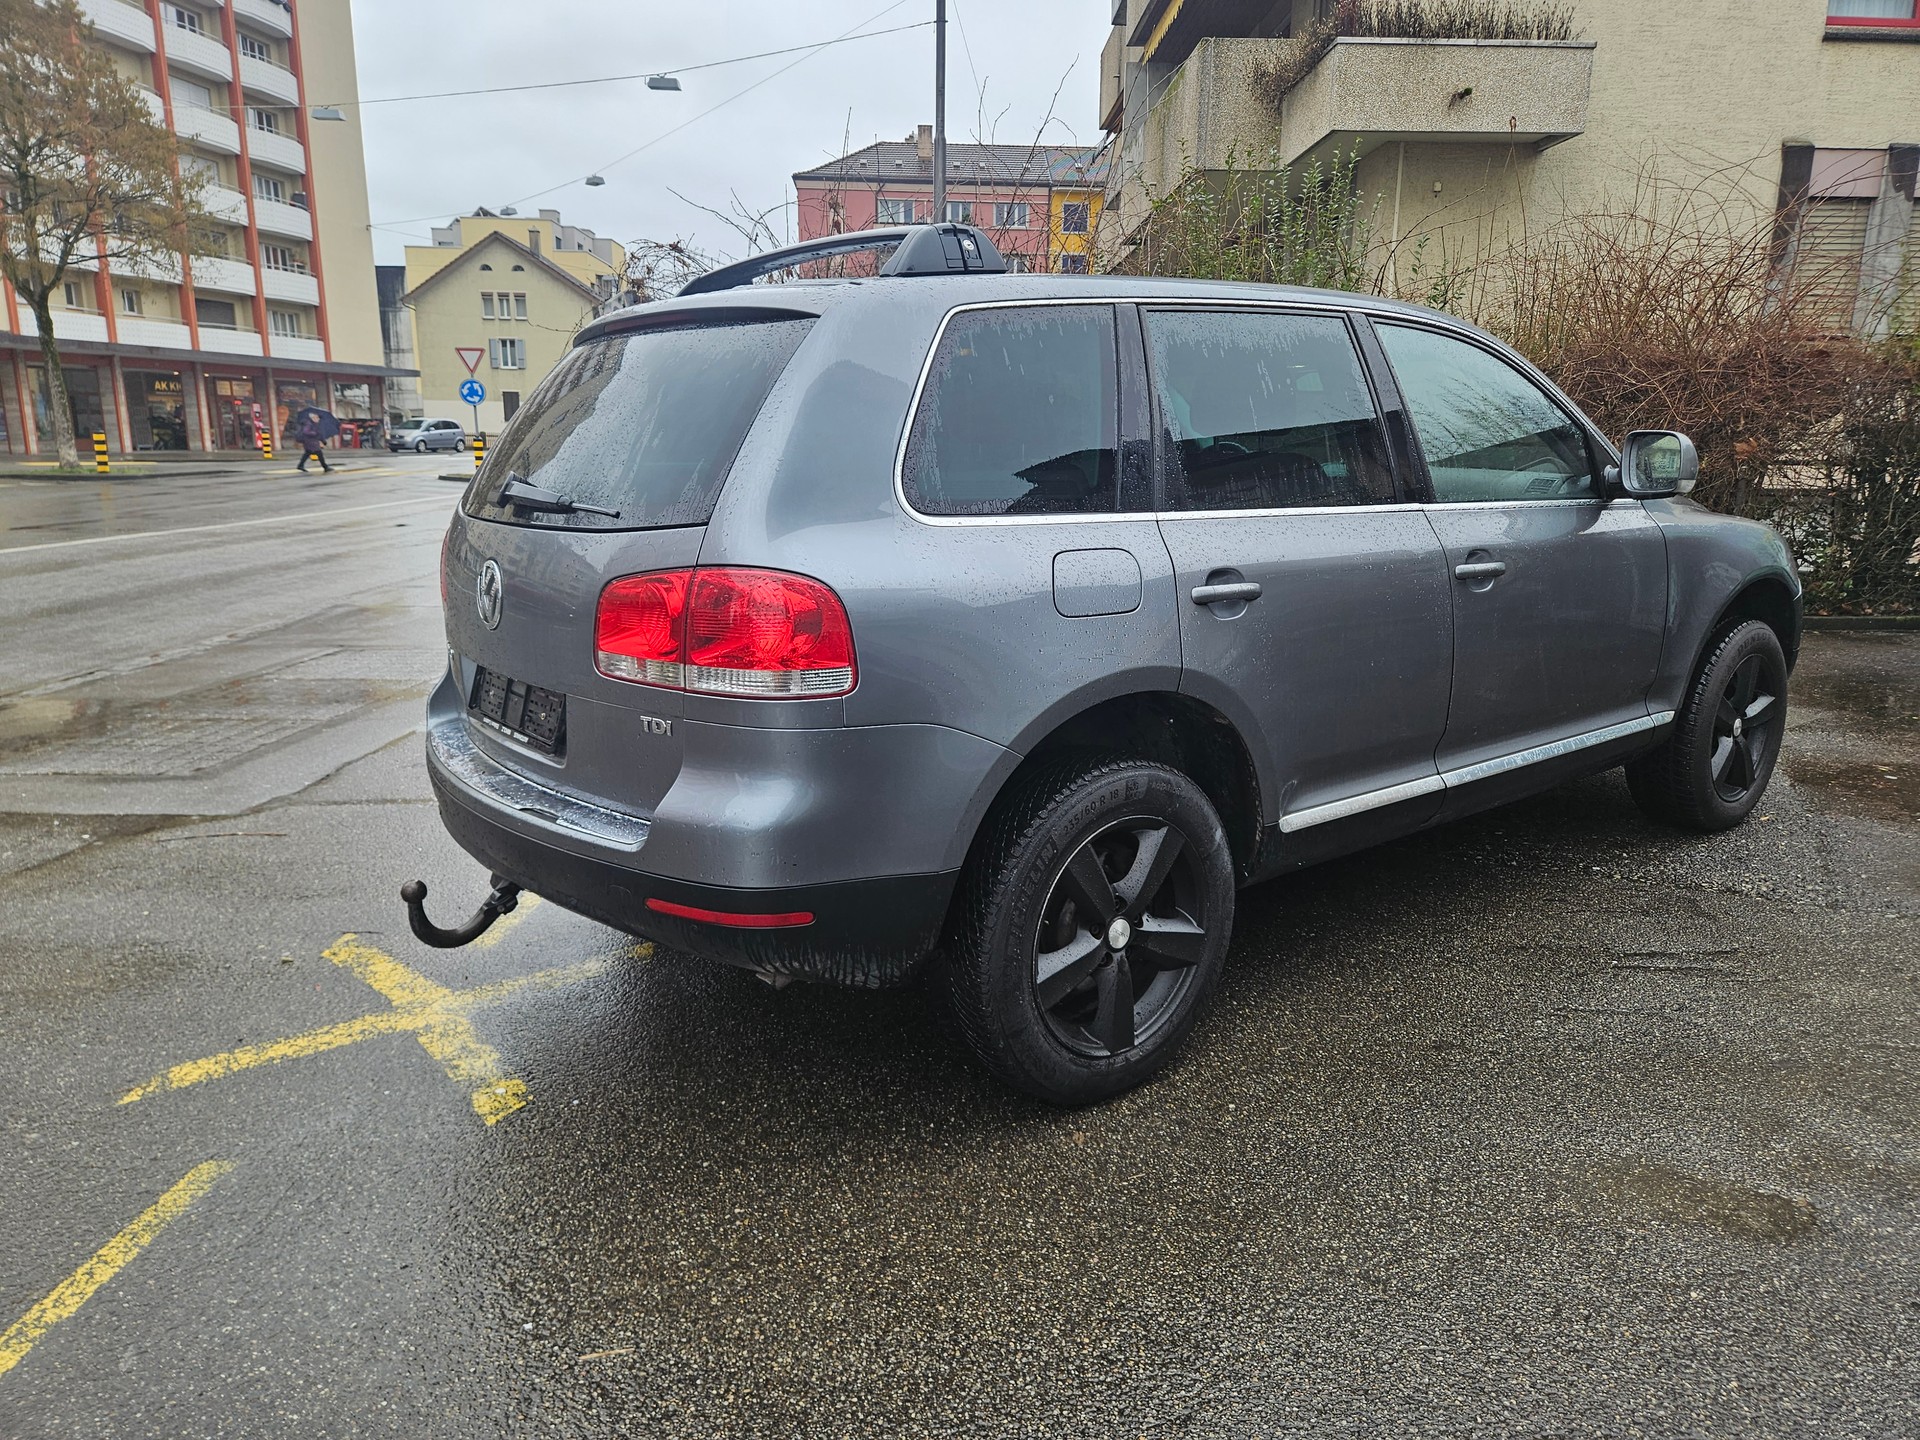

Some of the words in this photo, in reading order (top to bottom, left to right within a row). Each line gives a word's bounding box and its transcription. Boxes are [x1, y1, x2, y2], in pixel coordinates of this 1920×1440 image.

[154, 380, 168, 391] AK
[1063, 800, 1097, 835] 235/60
[1099, 795, 1107, 807] R
[1109, 788, 1119, 801] 18
